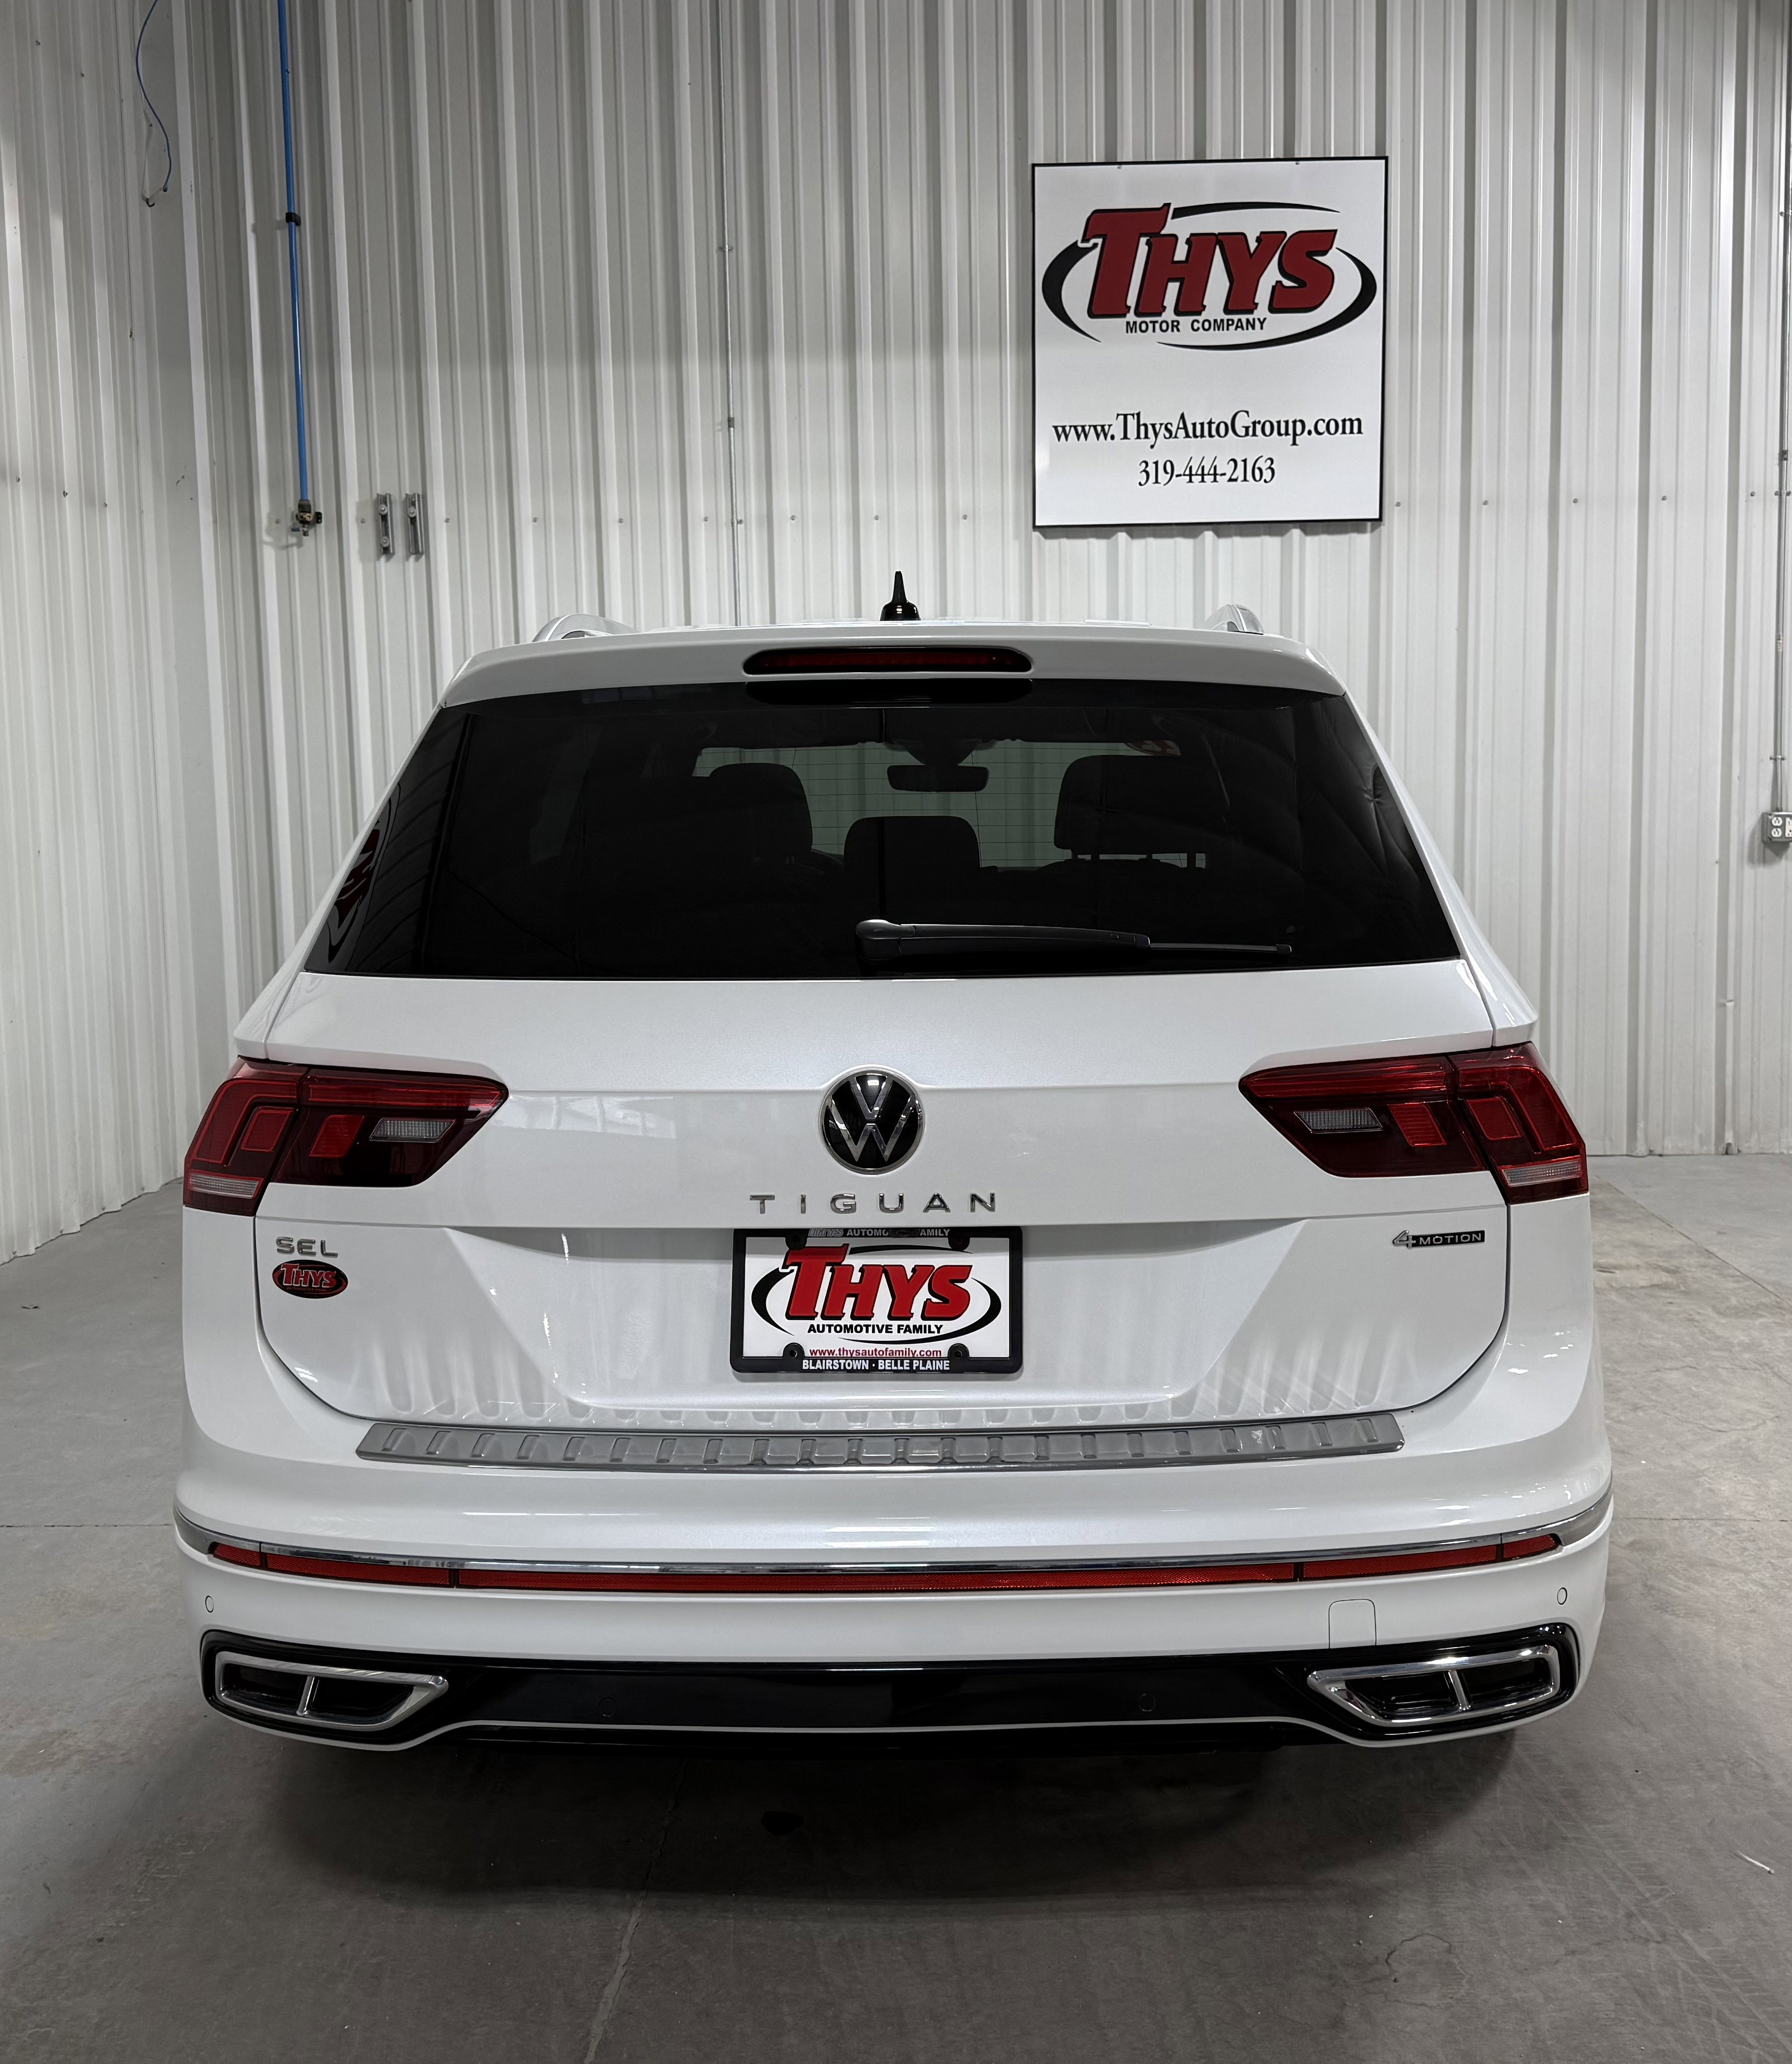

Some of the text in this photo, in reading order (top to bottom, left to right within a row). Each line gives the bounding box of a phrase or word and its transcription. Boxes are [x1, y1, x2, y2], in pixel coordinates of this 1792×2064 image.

[1081, 203, 1338, 318] THYS
[1125, 317, 1267, 334] MOTOR COMPANY
[1052, 410, 1364, 449] www.ThysAutoGroup.com
[1138, 455, 1276, 486] 319-444-2163
[750, 1192, 996, 1214] TIGUAN
[918, 1228, 950, 1236] AMILY
[276, 1236, 338, 1258] SEL
[281, 1263, 337, 1287] THYS
[782, 1243, 973, 1321] THYS
[807, 1324, 943, 1334] AUTOMOTIVE FAMILY
[809, 1347, 942, 1357] www.thysautofamily.com
[802, 1360, 950, 1371] BLAIRSTOWN BELLE PLAINE
